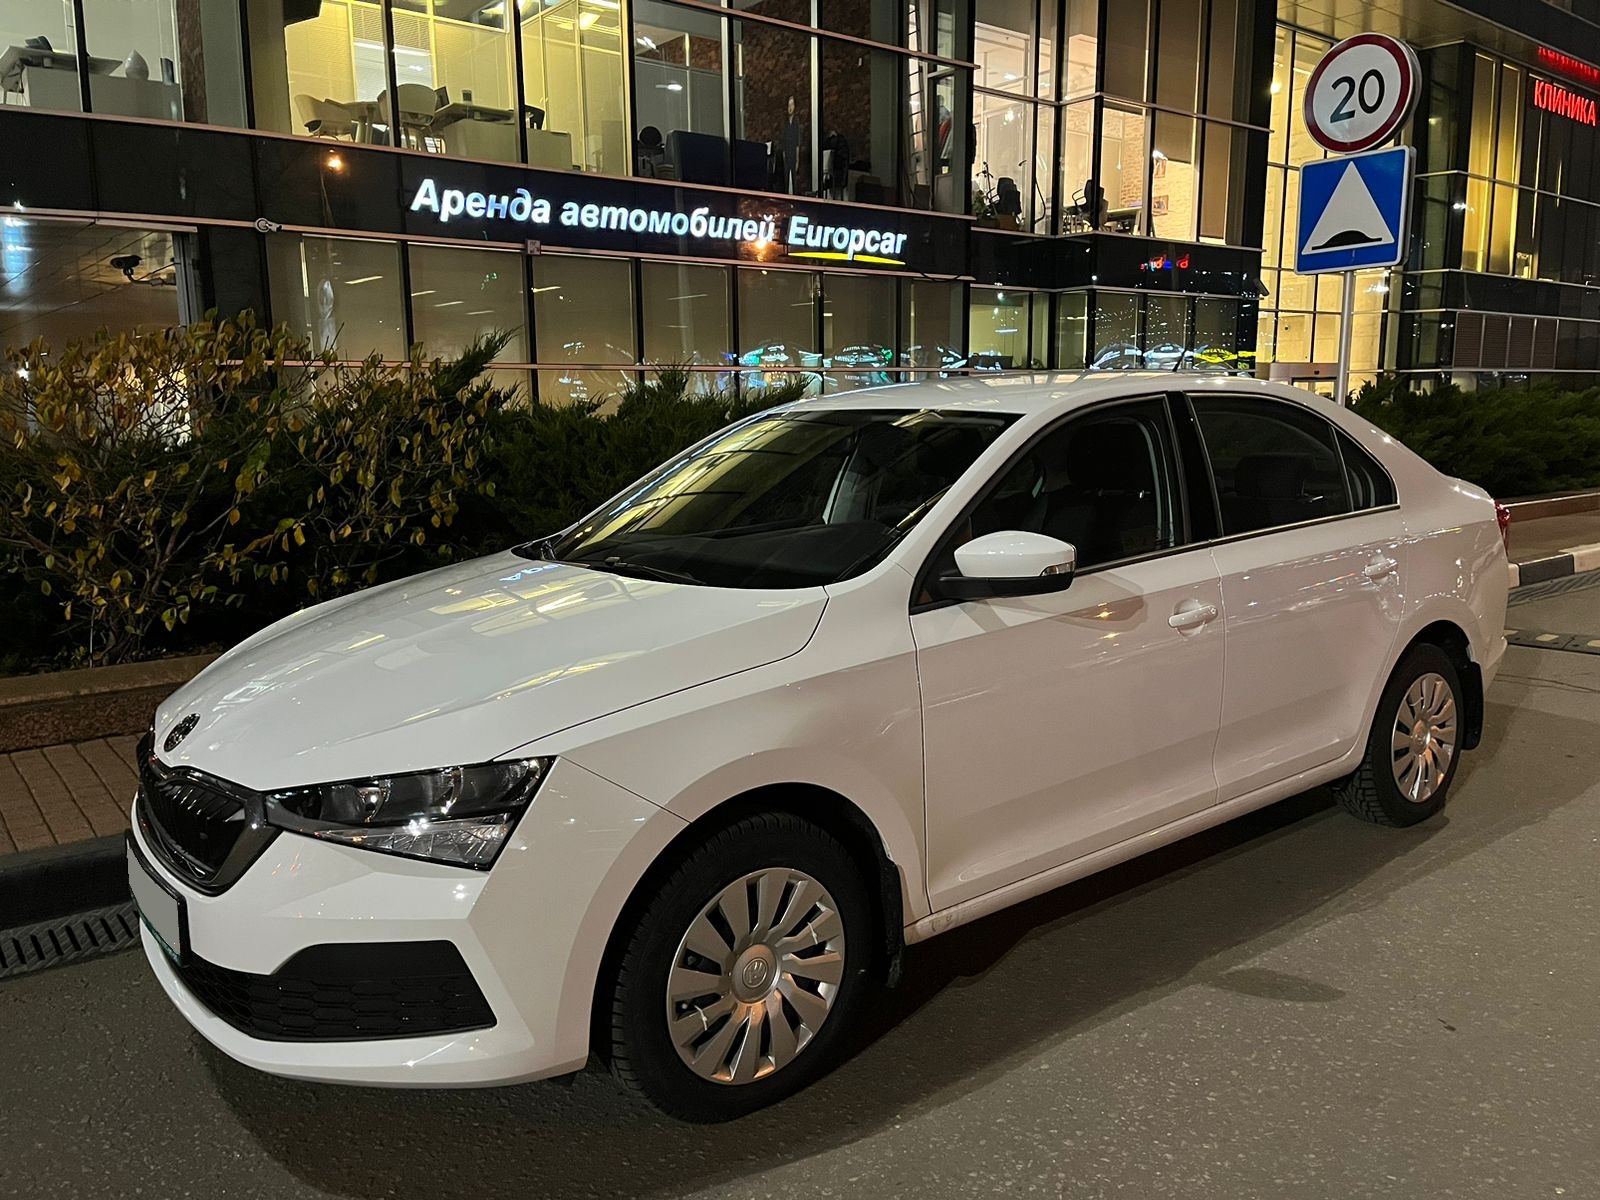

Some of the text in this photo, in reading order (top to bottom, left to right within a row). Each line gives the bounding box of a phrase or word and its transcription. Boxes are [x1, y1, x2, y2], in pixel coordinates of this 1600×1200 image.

[1330, 69, 1385, 124] 20
[1534, 79, 1596, 127] КЛИНИКА
[410, 178, 907, 260] Аренда автомобилей Europcar
